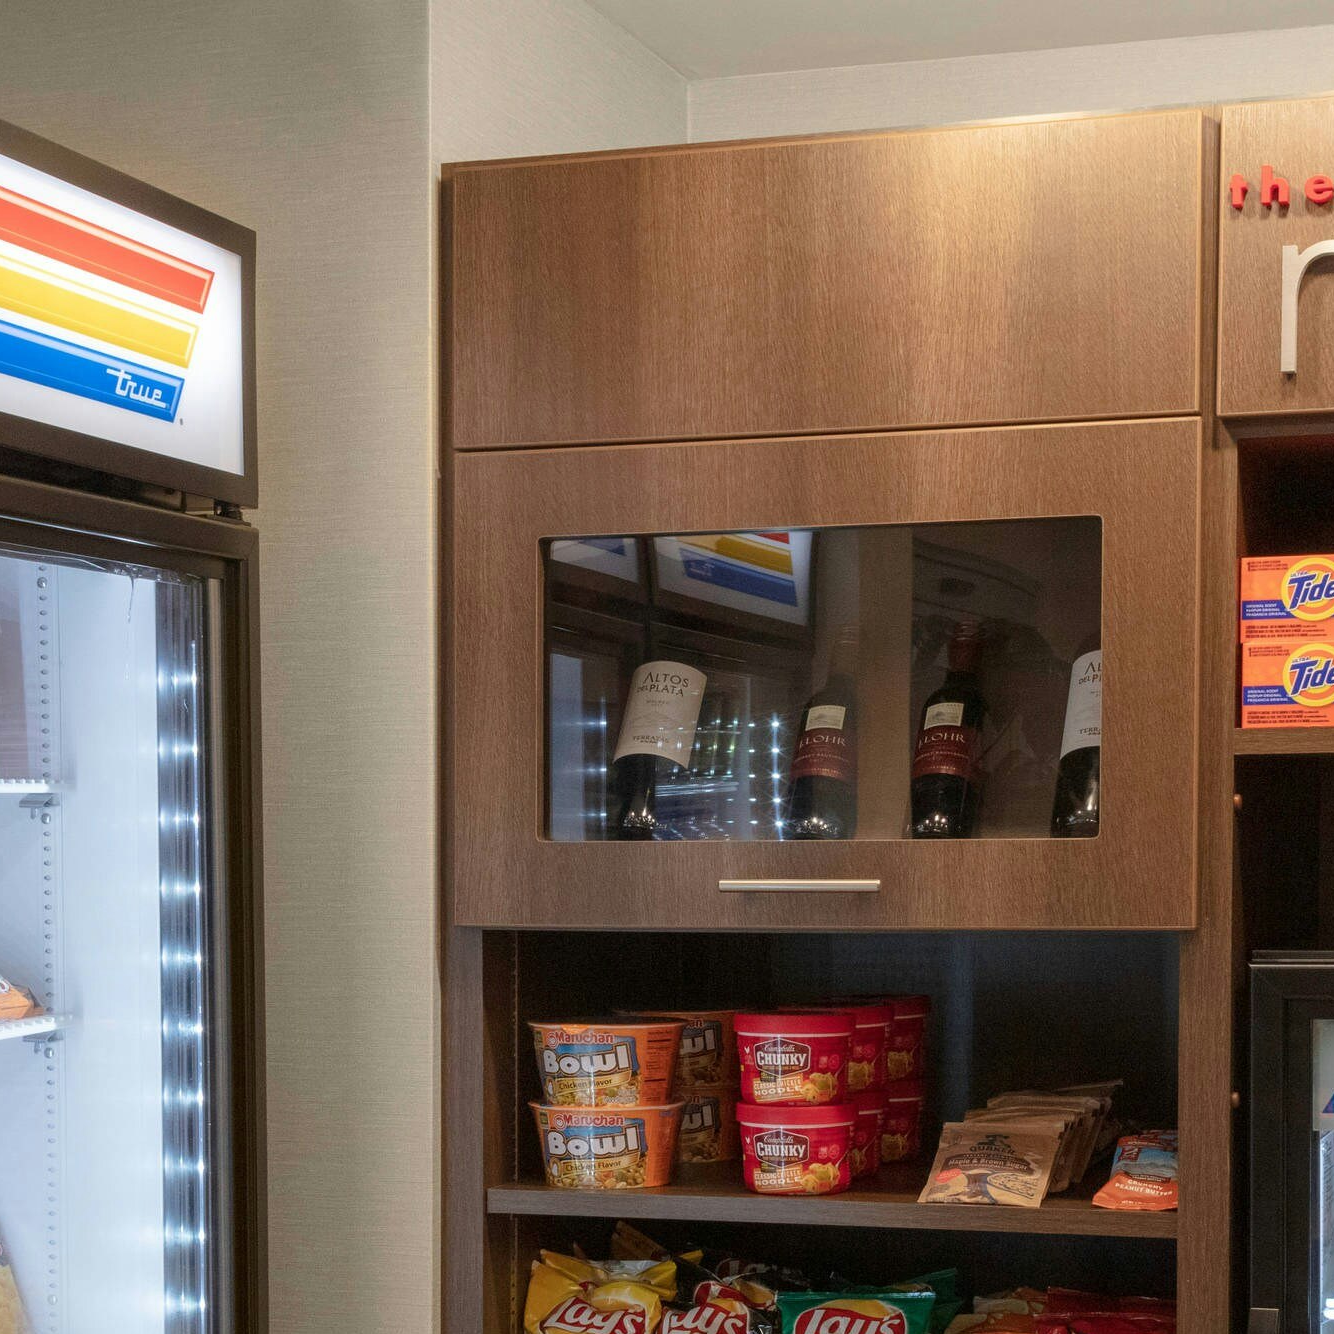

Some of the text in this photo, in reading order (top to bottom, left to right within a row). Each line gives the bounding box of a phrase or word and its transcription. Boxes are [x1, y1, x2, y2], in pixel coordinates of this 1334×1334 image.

[105, 366, 167, 408] true
[643, 671, 689, 688] ALTOS
[649, 683, 684, 697] PLATA
[805, 734, 846, 747] LOHR
[924, 731, 966, 744] LOHR
[554, 1030, 614, 1045] Maruchan
[543, 1044, 632, 1077] Bowl
[756, 1051, 808, 1067] CHUNKY
[754, 1086, 803, 1097] NOODLE
[563, 1114, 625, 1128] Maruchan
[546, 1126, 643, 1158] Bowl
[756, 1142, 806, 1158] CHUNKY
[948, 1157, 971, 1167] Maple
[979, 1159, 1006, 1168] Brown
[754, 1176, 803, 1187] NOODLE
[1114, 1182, 1147, 1196] PEANUT
